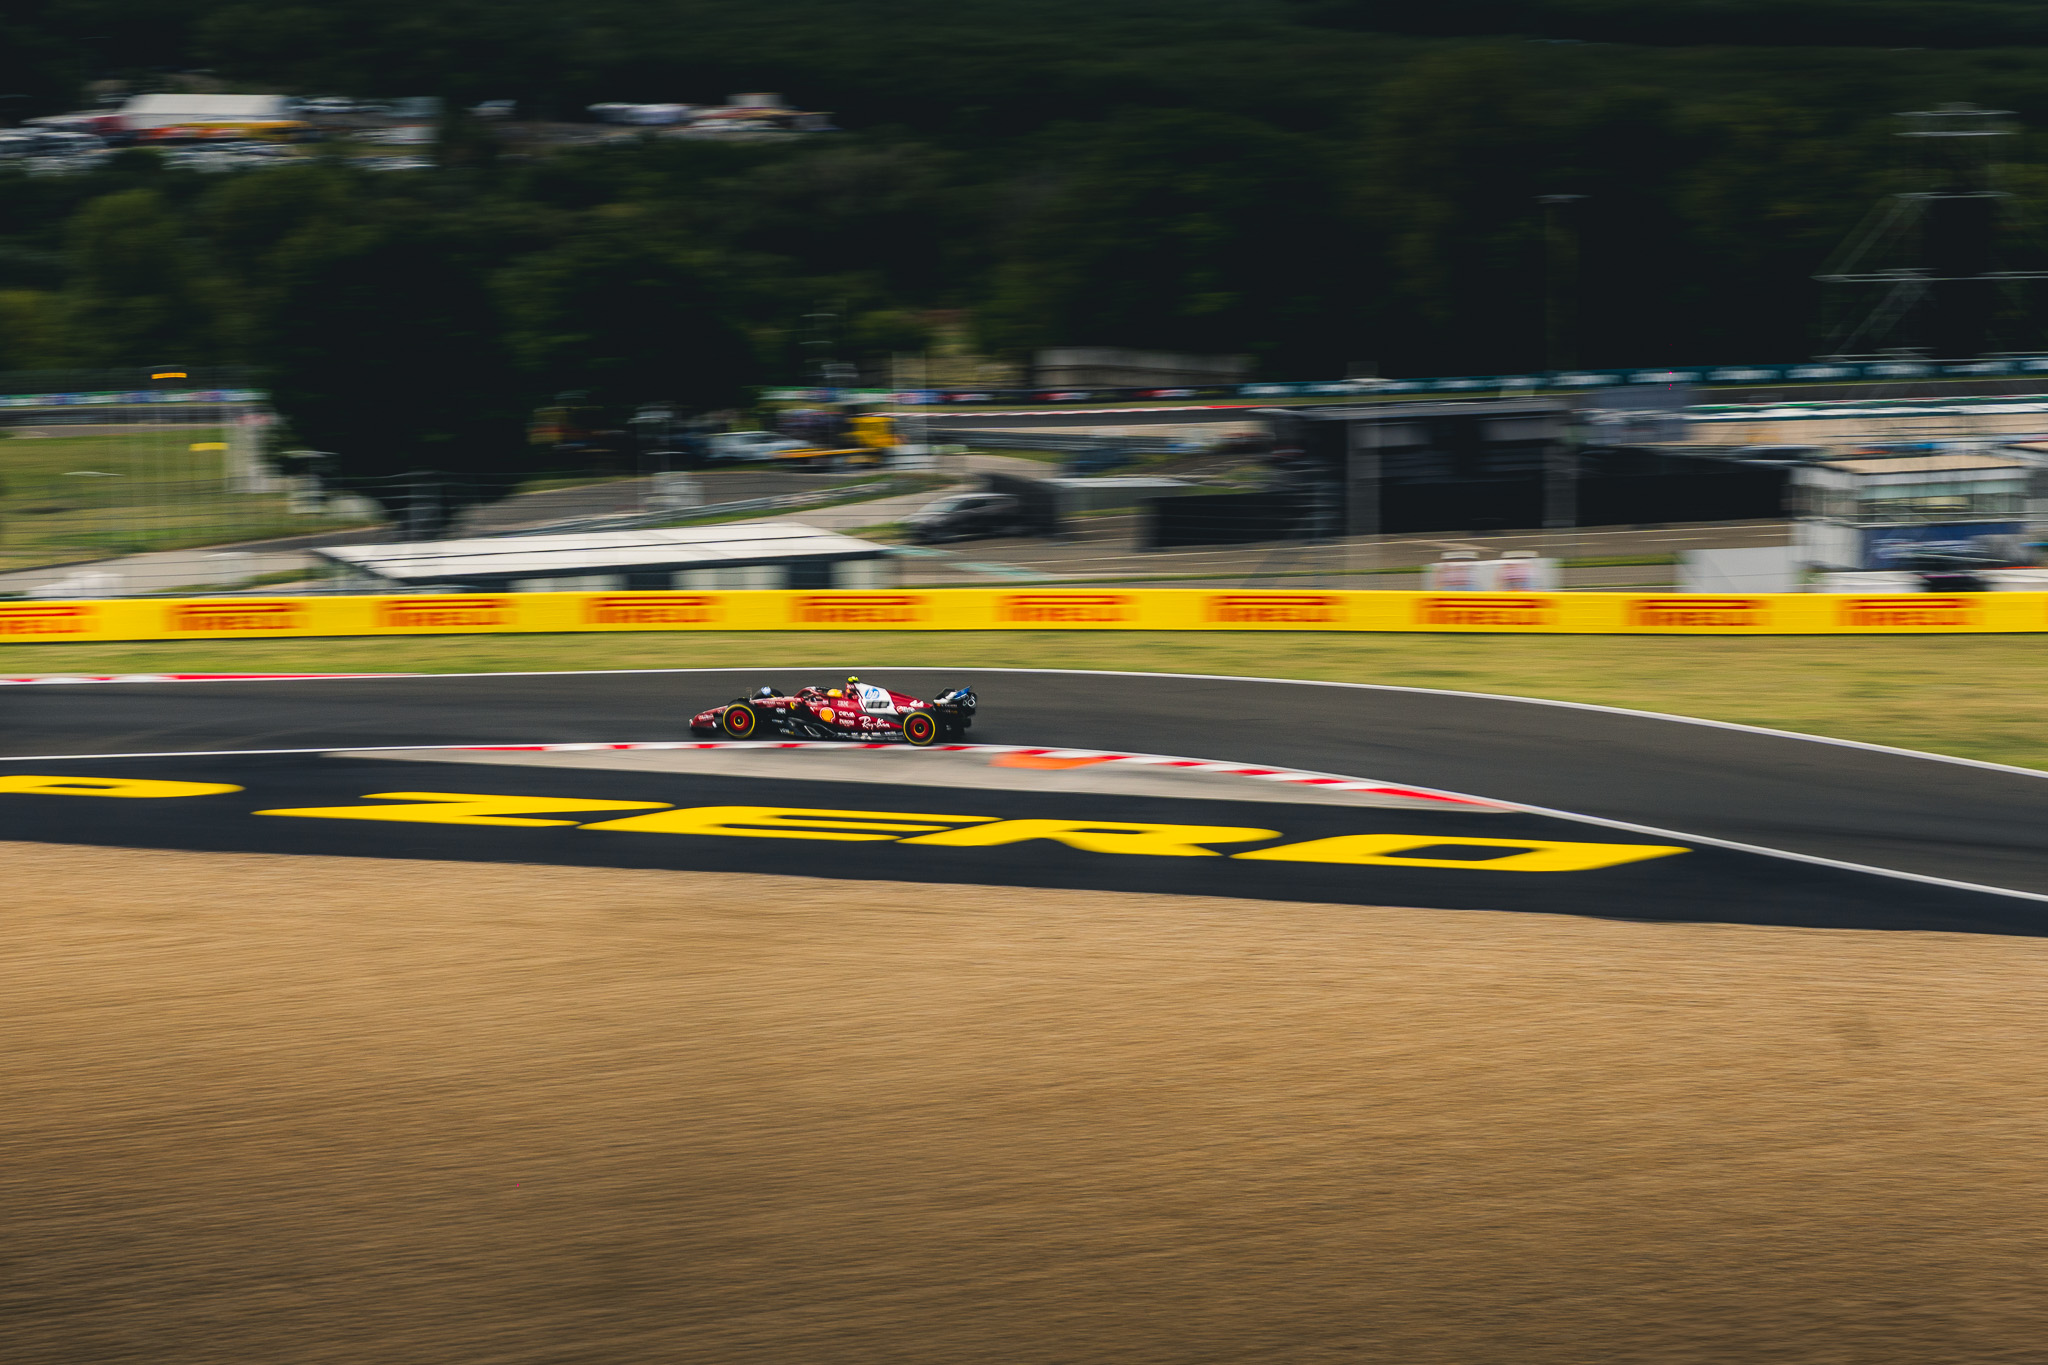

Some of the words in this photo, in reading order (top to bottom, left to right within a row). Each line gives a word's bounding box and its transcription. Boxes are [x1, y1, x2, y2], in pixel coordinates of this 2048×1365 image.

[909, 700, 924, 708] 44
[858, 716, 890, 731] Ray-Ban
[251, 792, 1694, 872] ZERO
